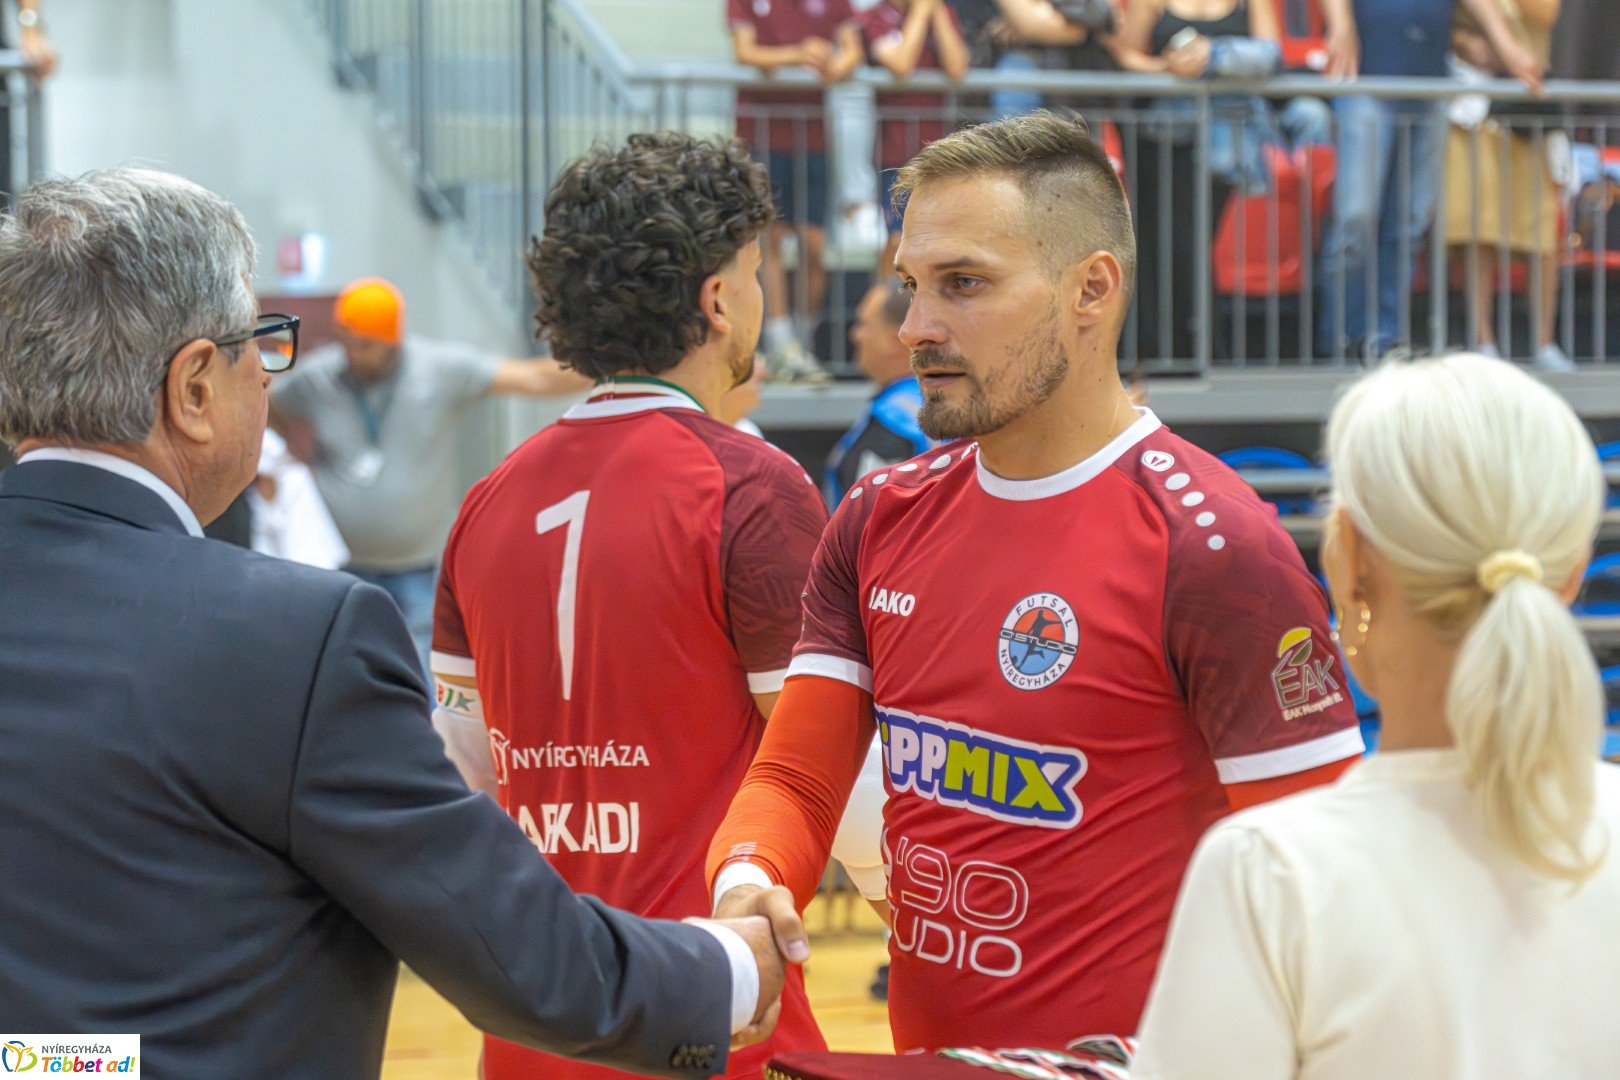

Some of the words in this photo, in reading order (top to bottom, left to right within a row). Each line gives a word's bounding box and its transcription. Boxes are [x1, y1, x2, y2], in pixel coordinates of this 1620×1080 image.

[535, 490, 591, 700] 1
[1015, 595, 1074, 628] FUTSAL
[1271, 655, 1340, 709] EAK
[512, 739, 650, 769] NYÍRGYHÁZA
[890, 907, 1022, 977] UDIO
